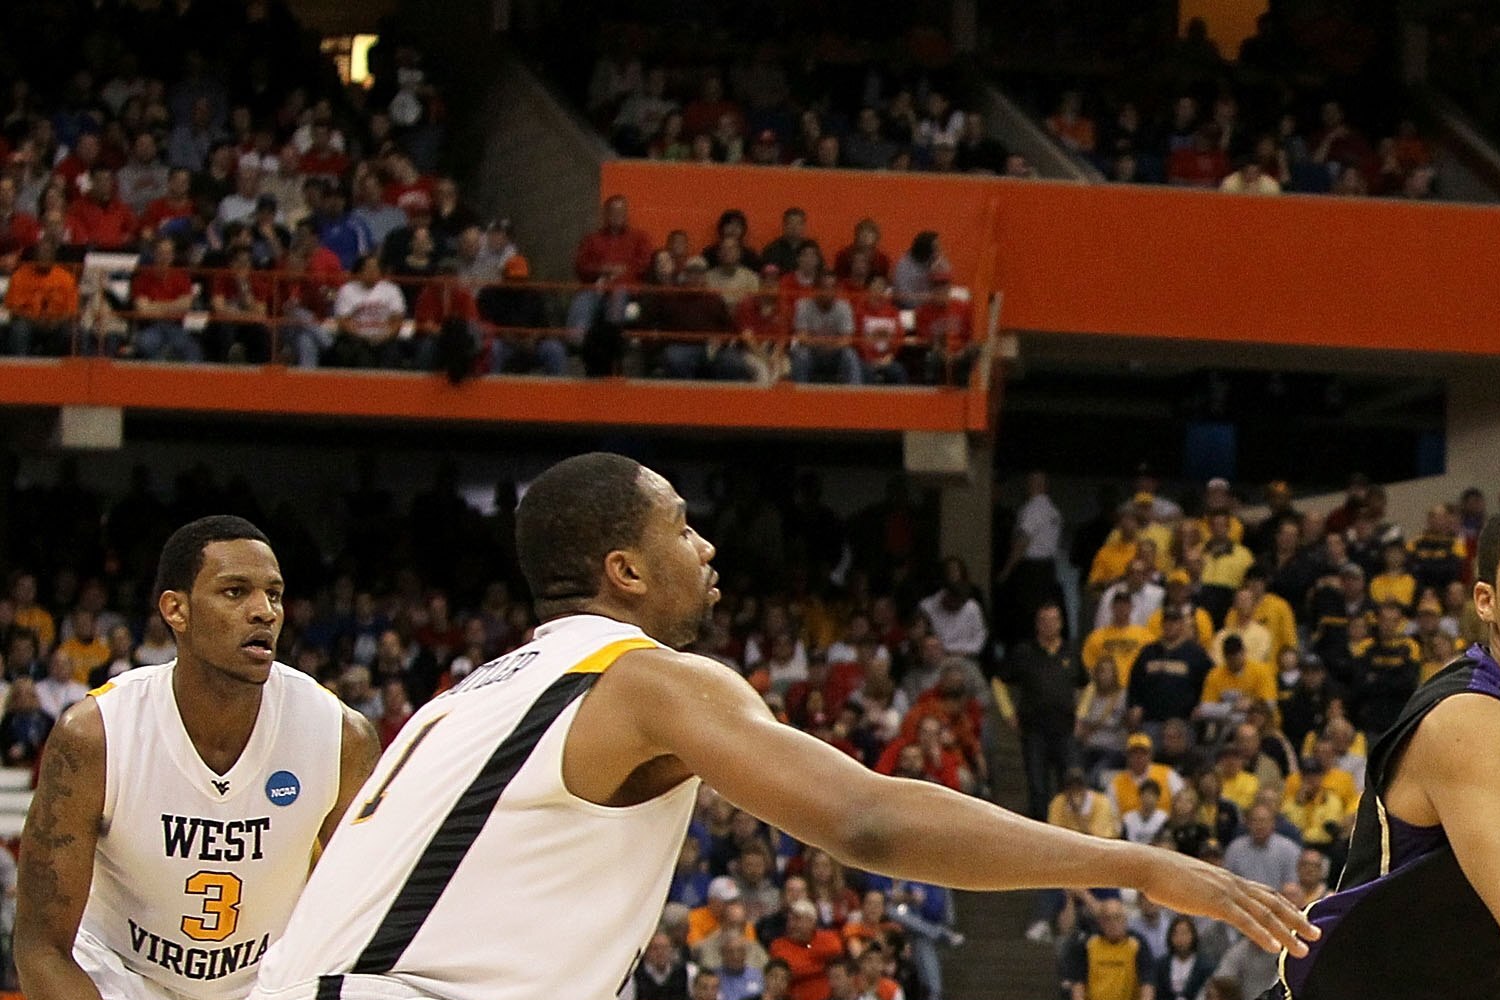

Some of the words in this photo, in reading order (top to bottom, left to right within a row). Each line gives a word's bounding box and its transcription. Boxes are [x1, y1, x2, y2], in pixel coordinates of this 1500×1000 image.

[271, 786, 297, 798] NCAA
[161, 813, 270, 861] WEST
[180, 870, 242, 942] 3
[128, 918, 270, 981] VIRGINIA
